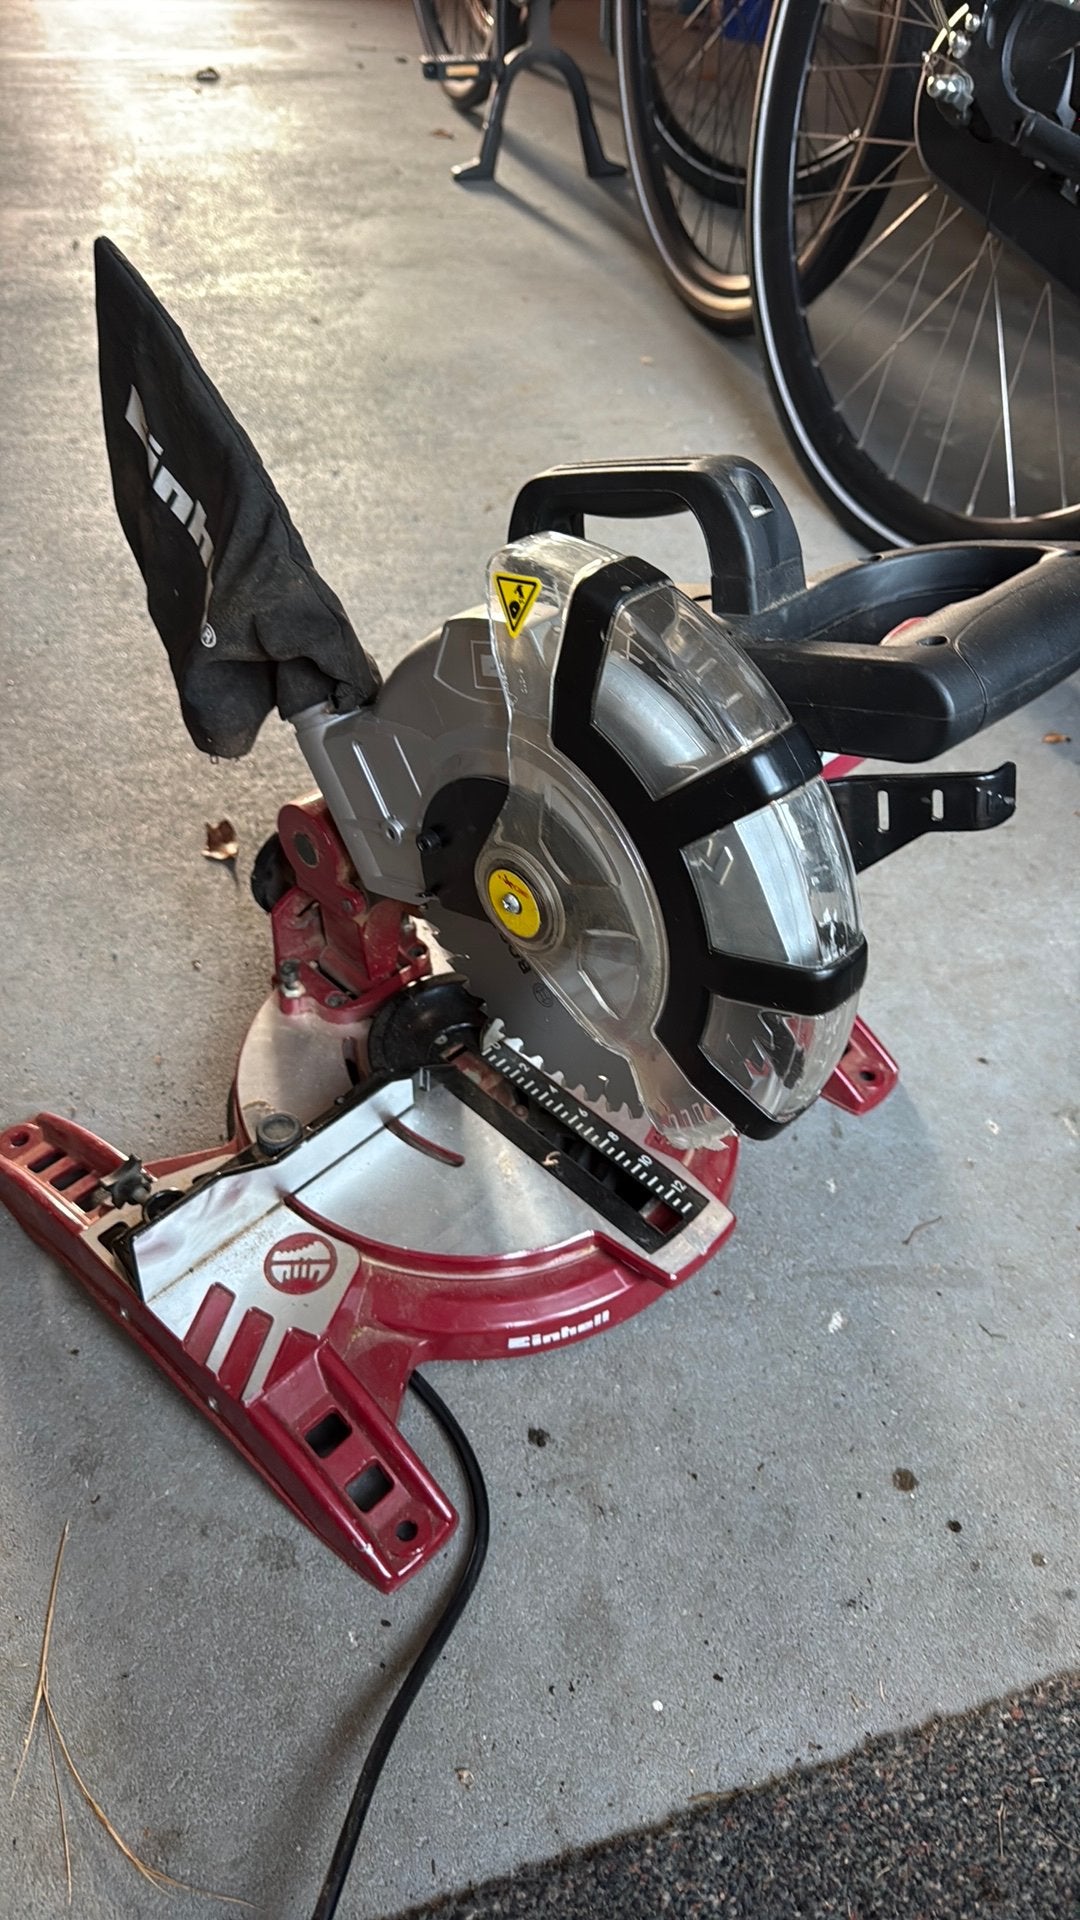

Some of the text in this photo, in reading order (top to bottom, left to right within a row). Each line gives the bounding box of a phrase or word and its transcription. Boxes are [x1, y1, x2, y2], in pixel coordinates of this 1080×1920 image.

[518, 1062, 531, 1073] 2
[548, 1084, 559, 1094] 4
[578, 1107, 589, 1118] 6
[607, 1130, 620, 1142] 8
[637, 1154, 653, 1167] 10
[670, 1179, 687, 1193] 12
[507, 1309, 610, 1349] Einhell
